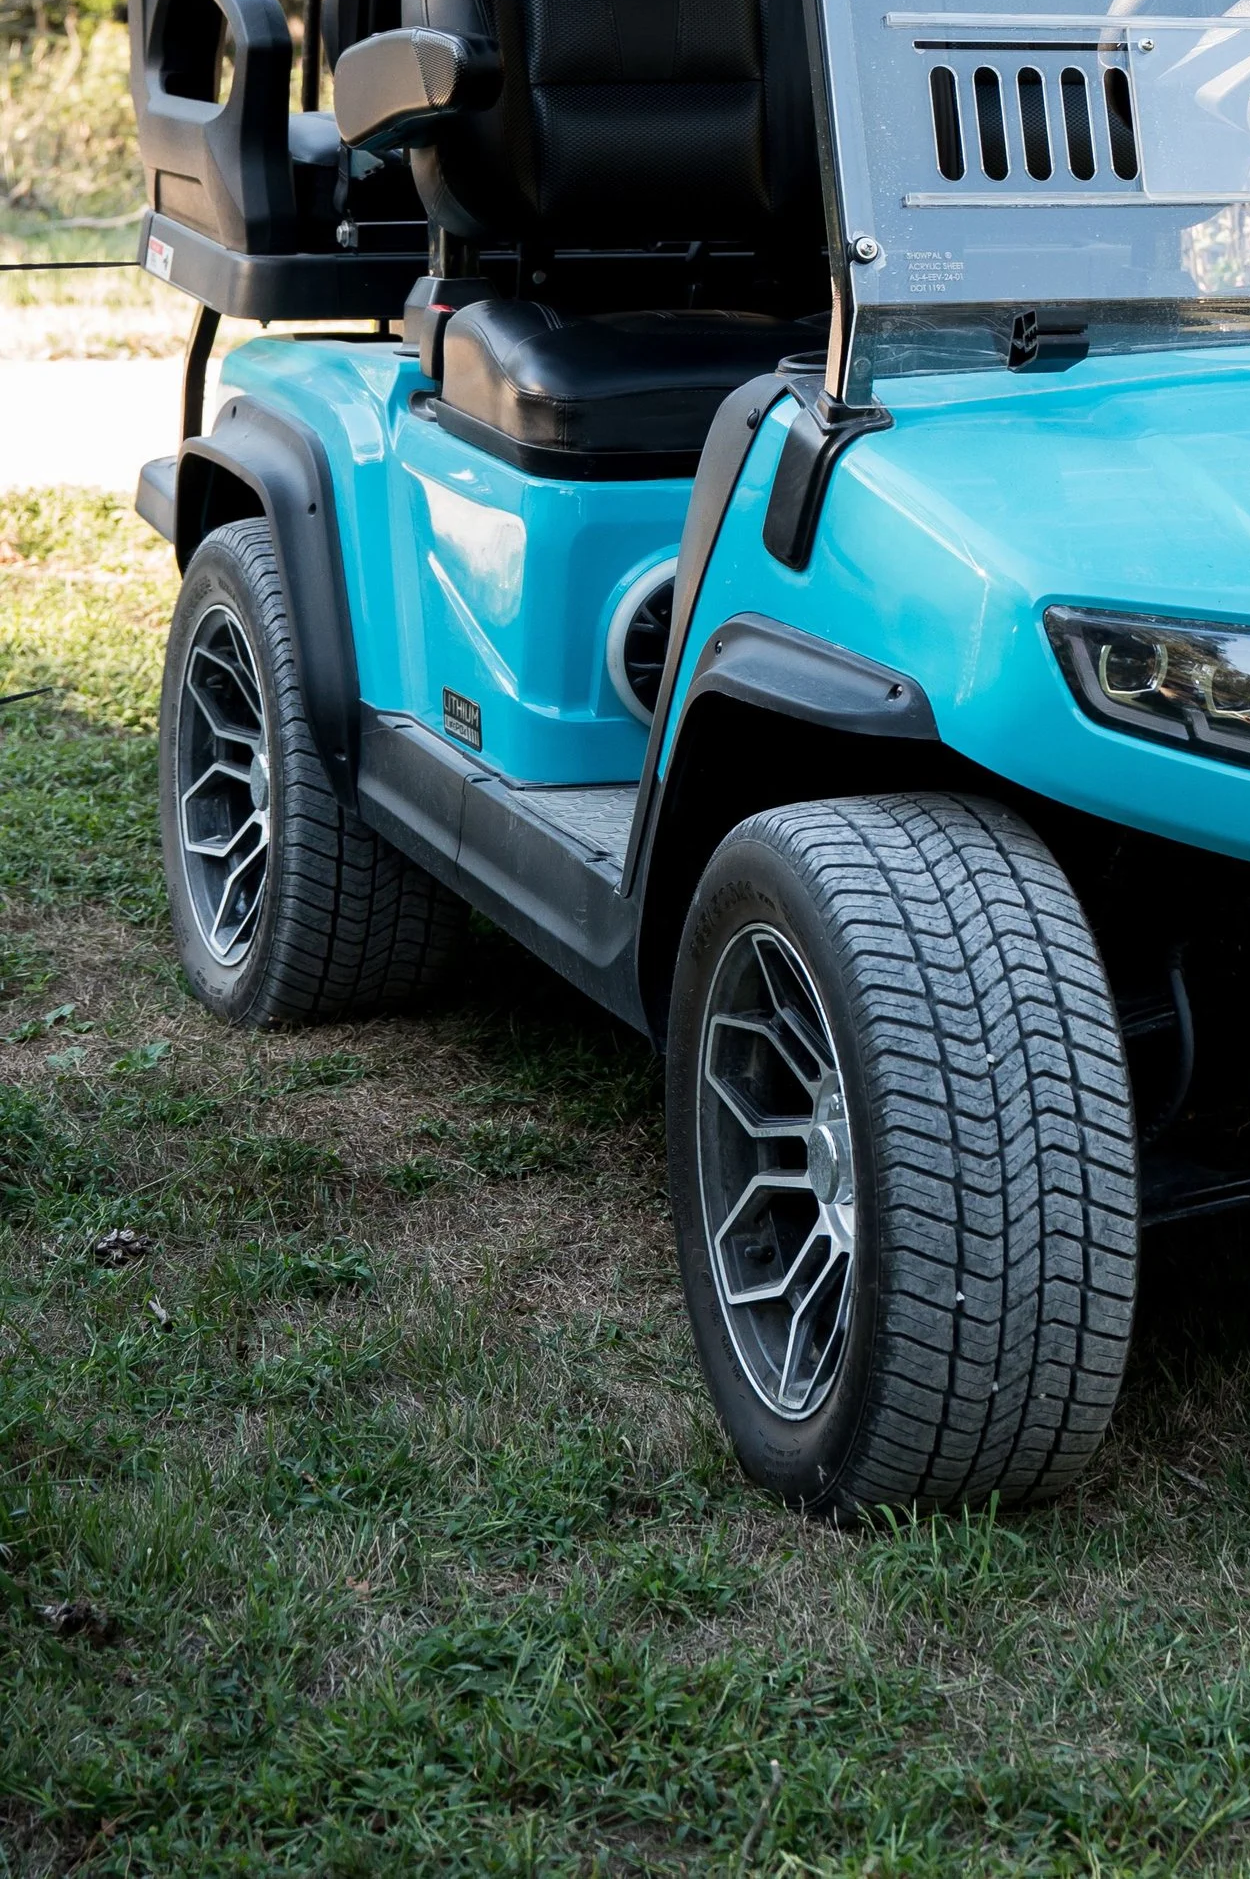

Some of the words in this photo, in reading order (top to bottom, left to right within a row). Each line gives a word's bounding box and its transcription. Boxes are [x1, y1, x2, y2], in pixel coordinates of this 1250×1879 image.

[908, 262, 941, 270] ACRYLIC
[942, 262, 964, 270] SHEET
[910, 284, 927, 292] DOT
[444, 690, 479, 727] LITHIUM
